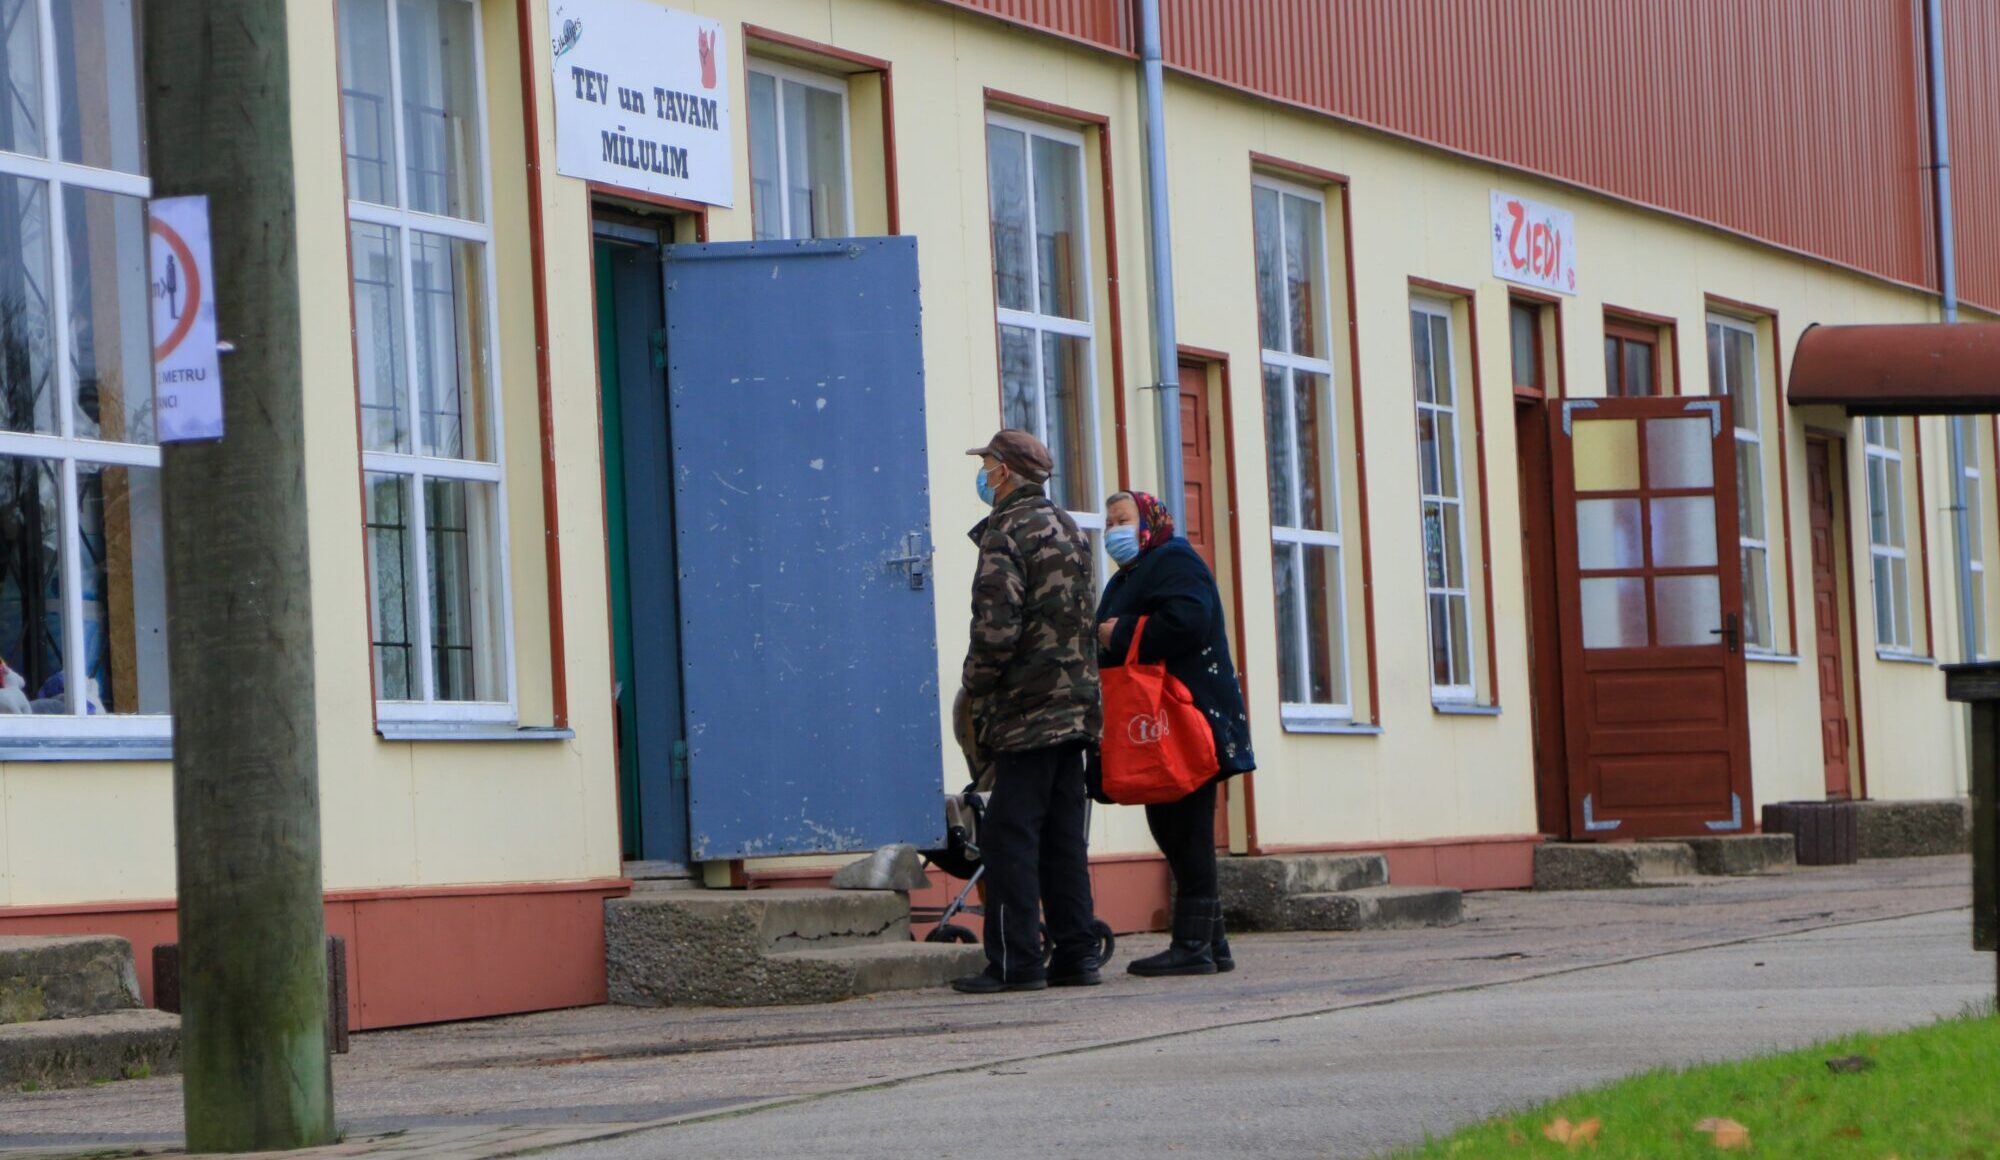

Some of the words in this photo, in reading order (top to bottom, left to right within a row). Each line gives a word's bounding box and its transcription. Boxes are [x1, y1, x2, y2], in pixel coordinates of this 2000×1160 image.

[571, 66, 609, 105] TEV
[618, 86, 646, 115] un
[653, 87, 719, 131] TAVAM
[601, 125, 689, 180] MĪLULIM
[1507, 201, 1561, 281] ZIEDI
[162, 367, 206, 384] METRU
